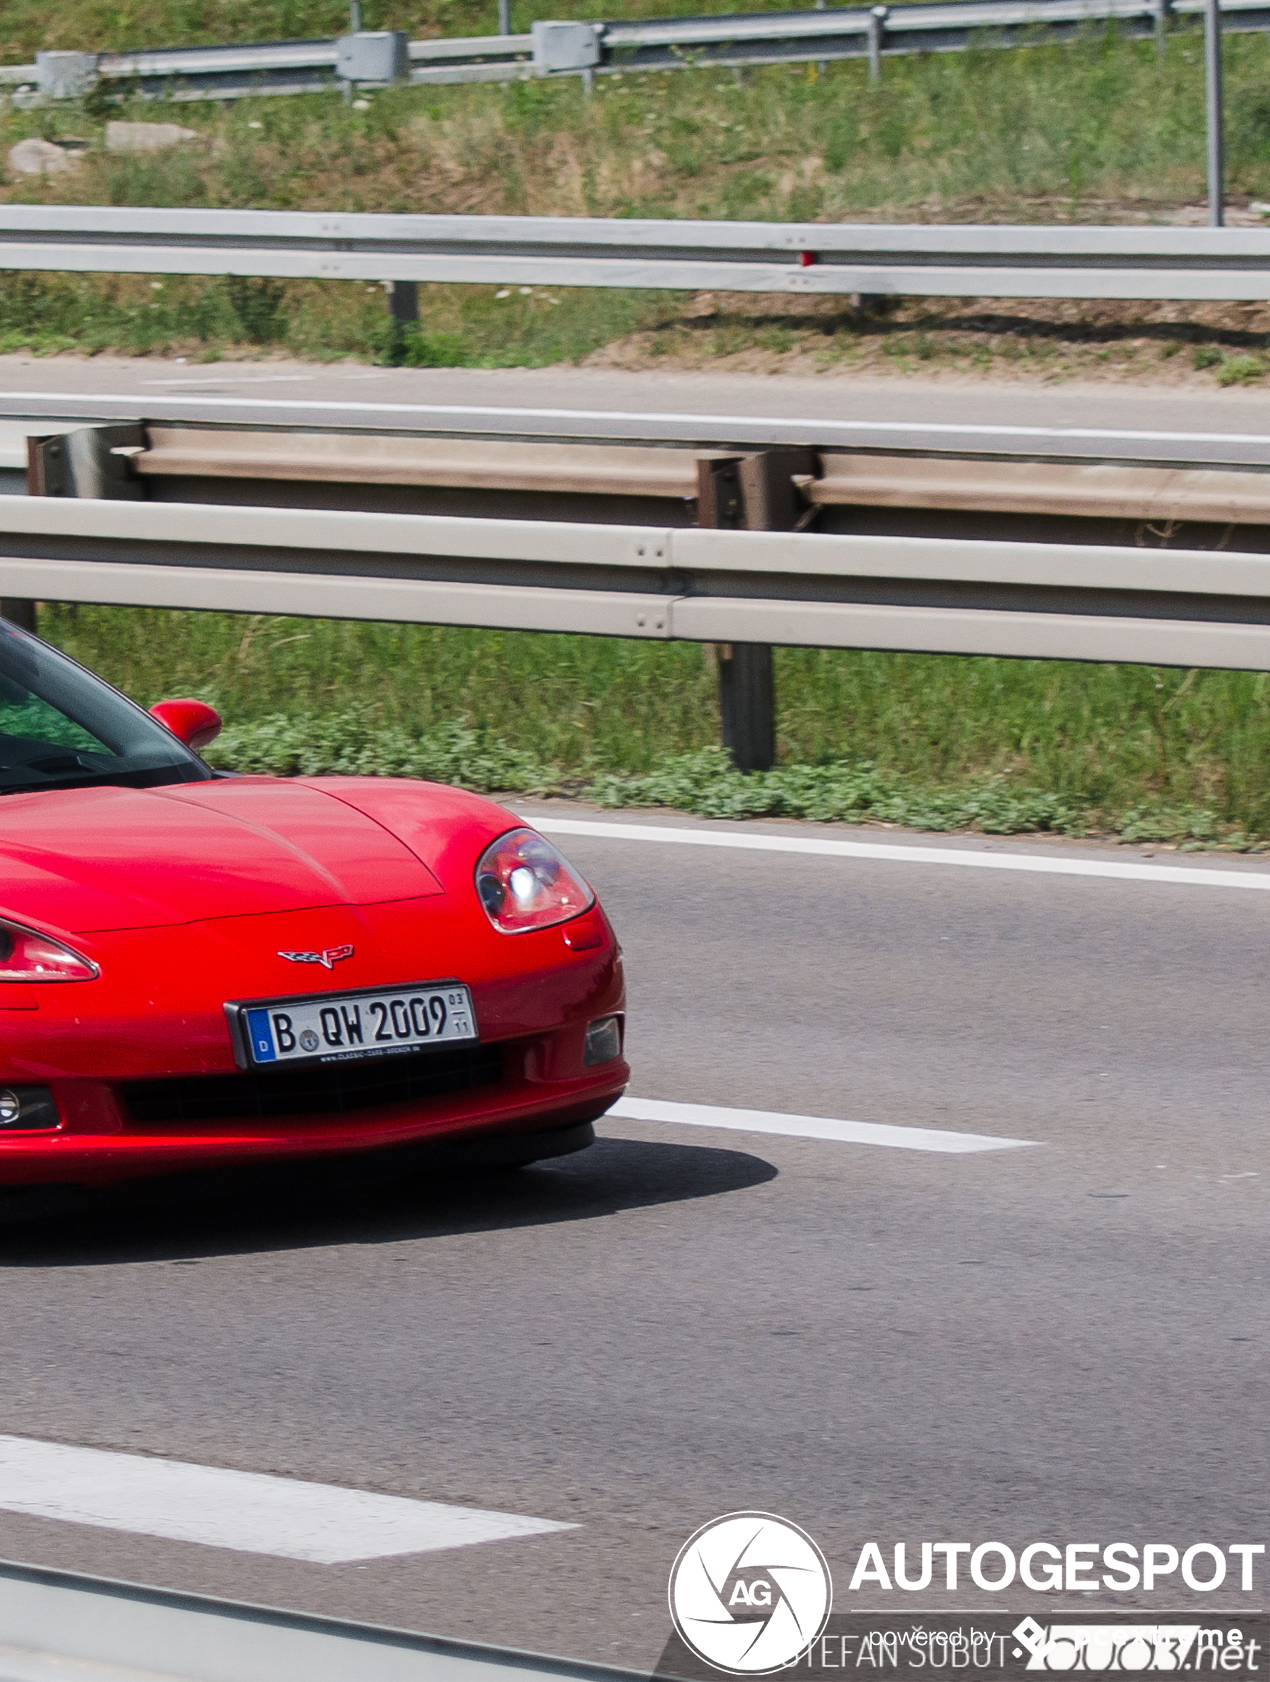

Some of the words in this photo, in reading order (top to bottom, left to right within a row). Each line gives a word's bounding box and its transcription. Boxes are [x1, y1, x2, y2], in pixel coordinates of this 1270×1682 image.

[448, 993, 464, 1006] 03
[272, 1013, 297, 1053] B
[318, 1004, 364, 1047] QW
[369, 995, 447, 1042] 2009
[258, 1040, 269, 1052] D
